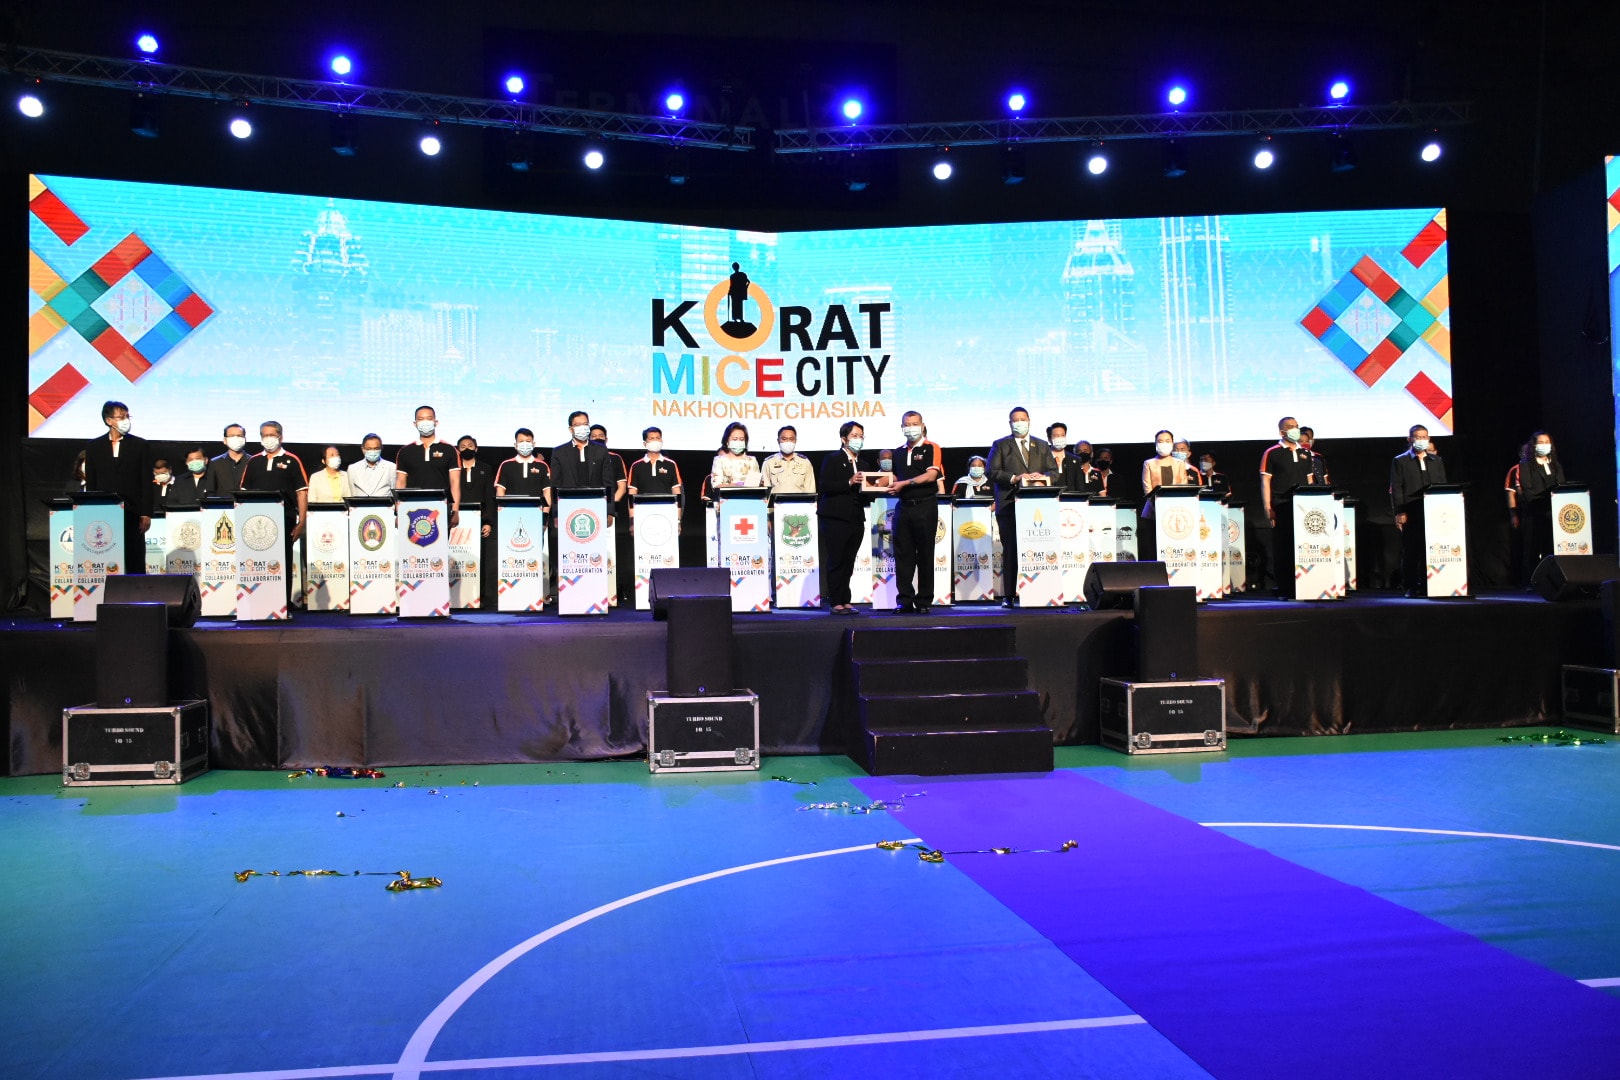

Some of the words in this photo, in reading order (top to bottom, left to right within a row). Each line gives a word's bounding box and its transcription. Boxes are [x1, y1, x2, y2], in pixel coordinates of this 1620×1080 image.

[652, 279, 890, 352] KORAT
[652, 353, 784, 397] MICE
[796, 355, 890, 397] CITY
[652, 399, 886, 419] NAKHONRATCHASIMA
[1298, 542, 1320, 550] KORAT
[562, 551, 588, 560] KORAT
[726, 554, 750, 562] KORAT
[1022, 550, 1044, 558] KORAT
[240, 558, 266, 566] KORAT
[354, 558, 378, 566] KORAT
[403, 556, 428, 564] KORAT
[502, 556, 525, 564] KORAT
[78, 560, 104, 569] KORAT
